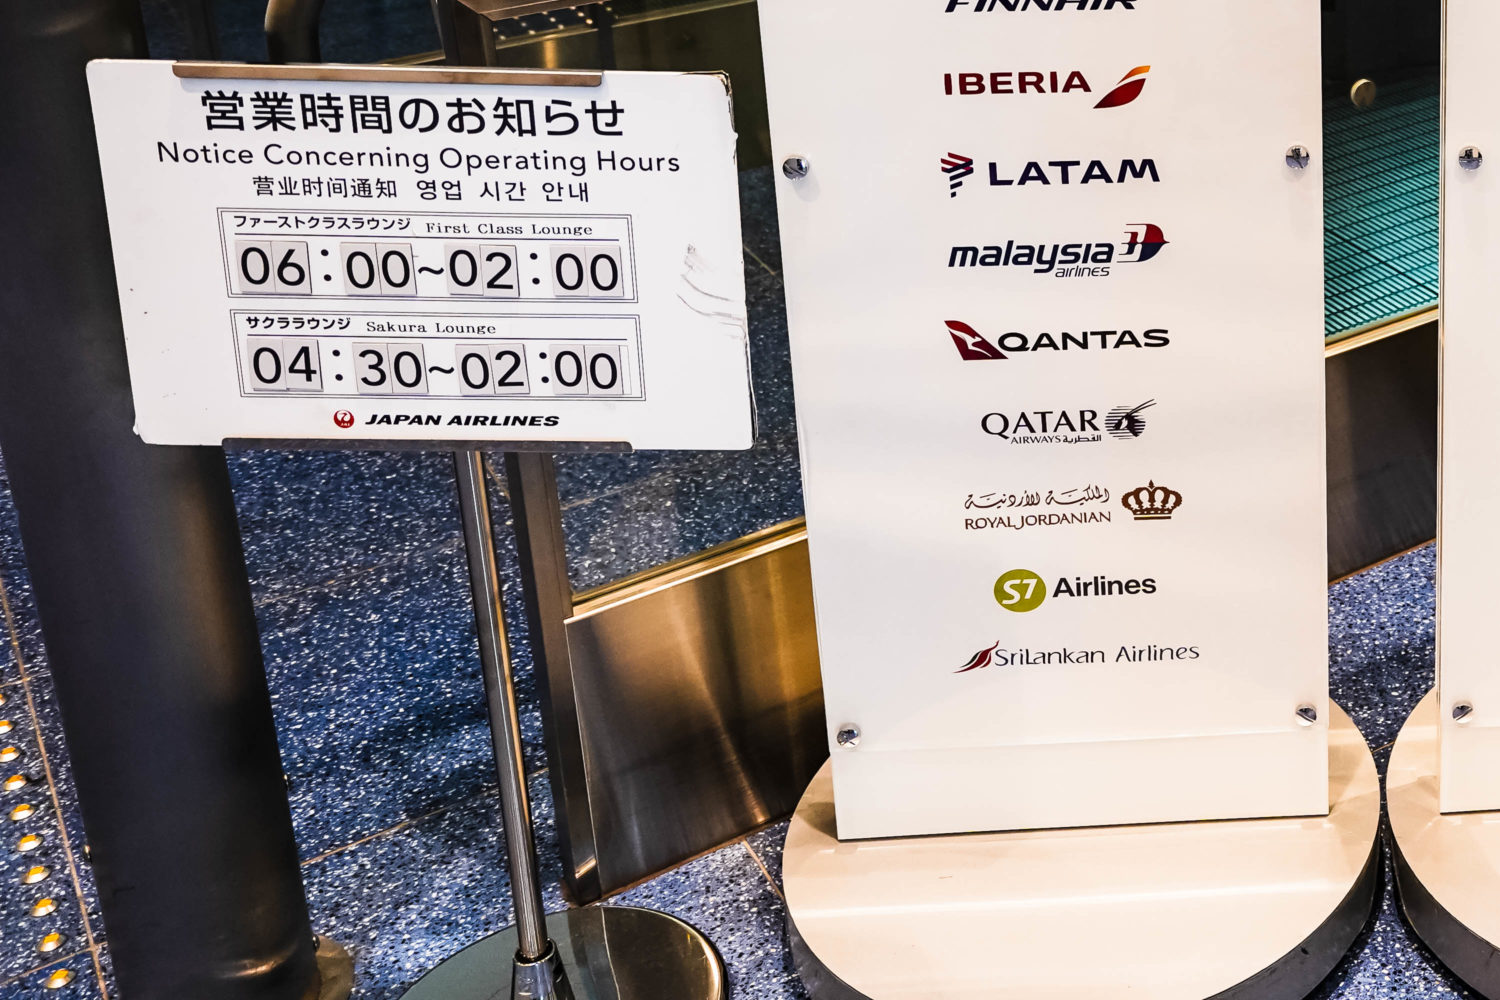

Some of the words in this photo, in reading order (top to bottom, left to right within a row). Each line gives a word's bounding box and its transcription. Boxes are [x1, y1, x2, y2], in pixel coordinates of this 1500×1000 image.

[943, 70, 1093, 96] IBERIA
[200, 89, 625, 138] 営業時間のお知らせ
[156, 141, 254, 164] Notice
[263, 143, 430, 174] Concerning
[439, 146, 587, 177] Operating
[597, 149, 681, 173] Hours
[988, 158, 1161, 186] LATAM
[252, 175, 398, 199] 营业时间通知
[416, 179, 462, 201] 영업
[479, 180, 527, 202] 시간
[541, 181, 590, 203] 안내
[233, 215, 411, 231] ファーストクラスラウンジ
[425, 222, 470, 235] First
[477, 222, 524, 236] Class
[531, 223, 593, 237] Lounge
[948, 239, 1116, 274] malaysia
[1054, 265, 1111, 278] airlines
[245, 316, 352, 331] サクララウンジ
[366, 321, 427, 333] Sakura
[435, 322, 497, 335] Lounge
[997, 328, 1171, 352] QANTAS
[364, 414, 442, 427] JAPAN
[446, 414, 561, 428] AIRLINES
[980, 409, 1101, 440] QATAR
[1010, 434, 1062, 445] AIRWAYS
[964, 516, 1016, 531] ROYAL
[1014, 511, 1112, 531] JORDANIAN
[1000, 578, 1038, 606] S7
[1052, 575, 1158, 599] Airlines
[994, 647, 1106, 668] SriLankan
[1115, 644, 1201, 664] Airlines
